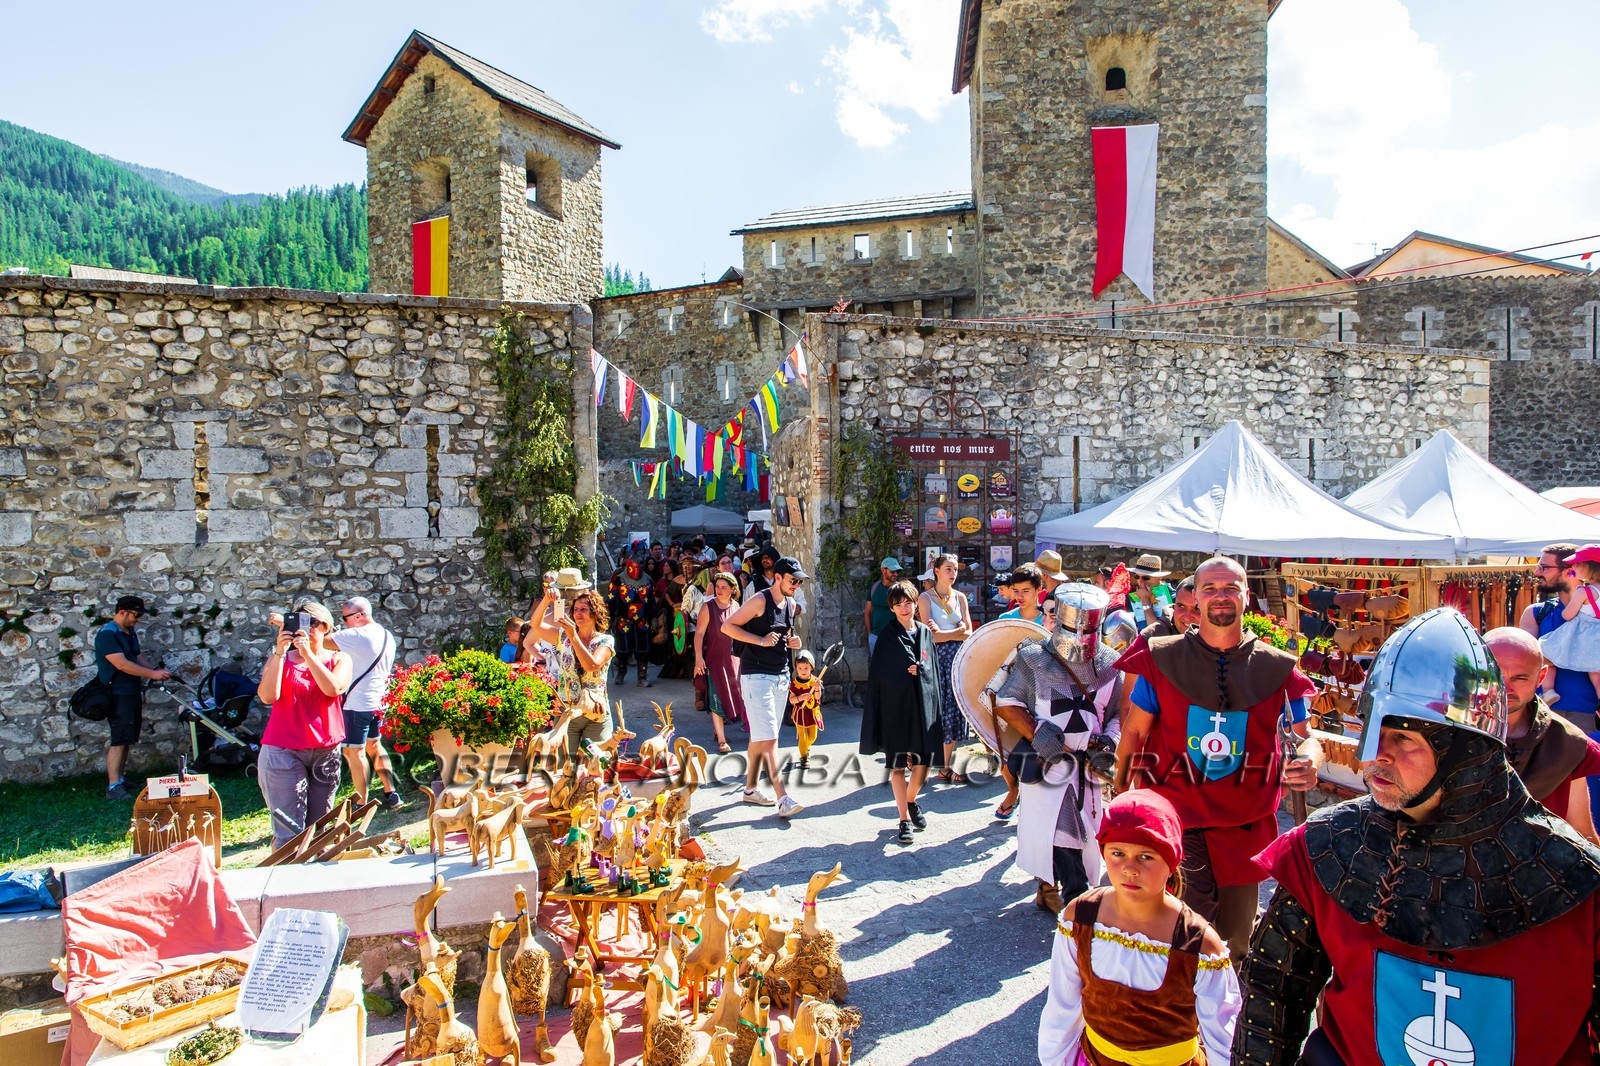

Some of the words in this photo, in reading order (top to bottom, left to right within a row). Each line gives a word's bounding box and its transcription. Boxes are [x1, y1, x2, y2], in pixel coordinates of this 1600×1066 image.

[909, 443, 936, 453] entre
[943, 444, 962, 454] nos
[968, 445, 995, 454] murs
